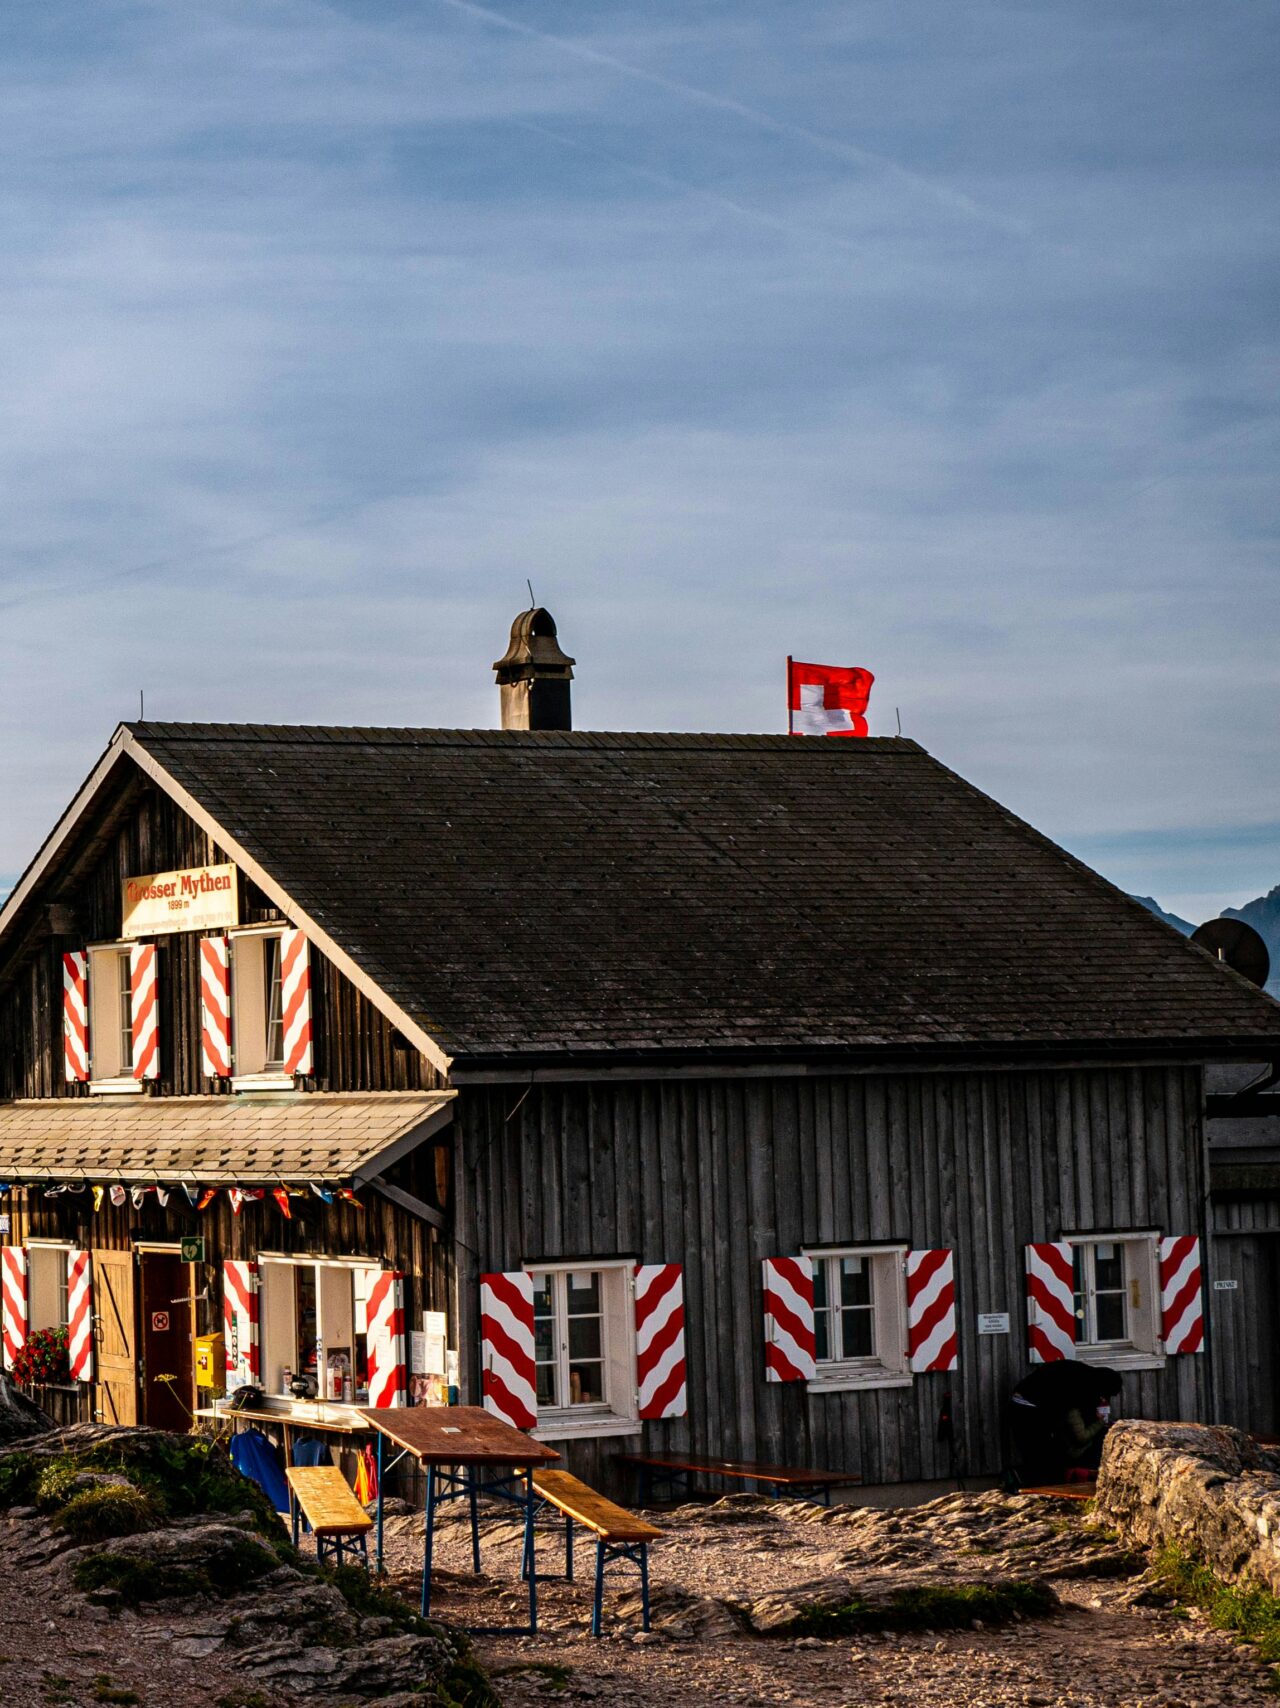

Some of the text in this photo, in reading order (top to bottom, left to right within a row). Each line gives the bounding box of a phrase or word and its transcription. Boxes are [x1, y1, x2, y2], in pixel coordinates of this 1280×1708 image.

[128, 873, 231, 902] Grosser Mythen
[168, 899, 183, 910] 1899
